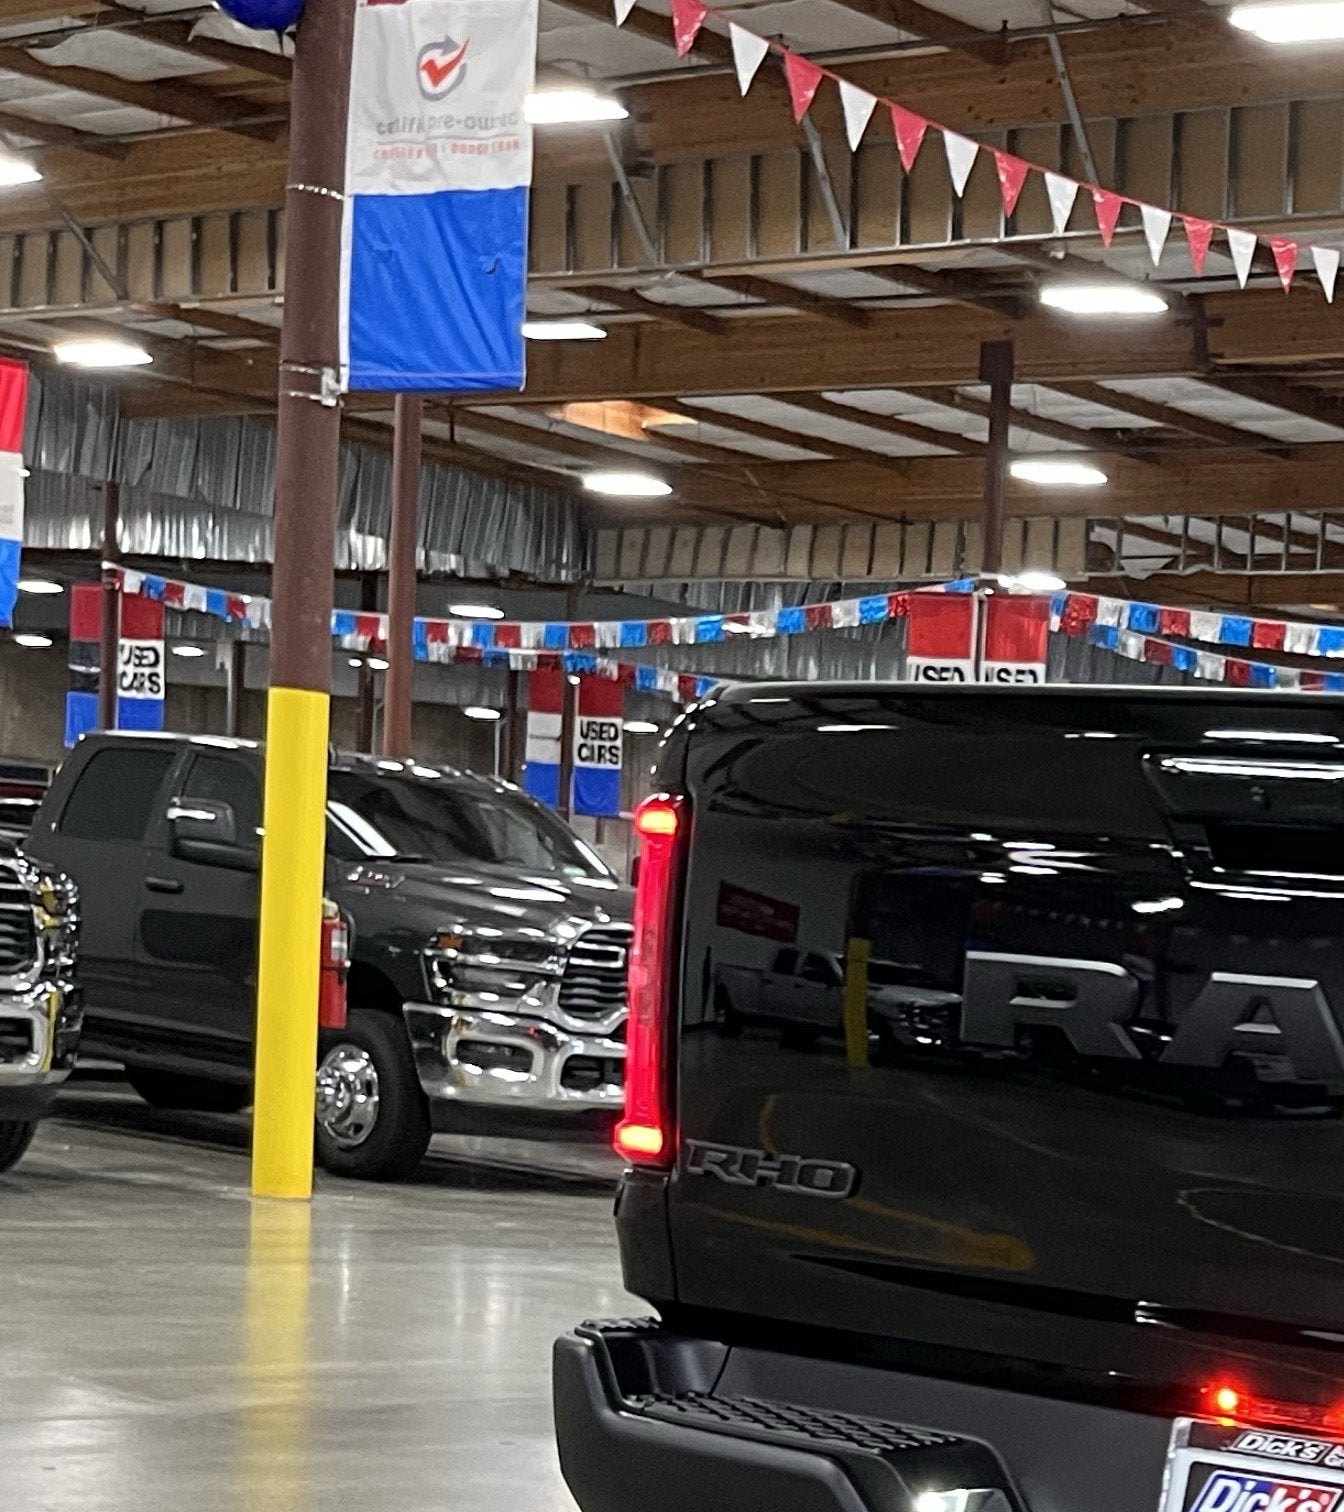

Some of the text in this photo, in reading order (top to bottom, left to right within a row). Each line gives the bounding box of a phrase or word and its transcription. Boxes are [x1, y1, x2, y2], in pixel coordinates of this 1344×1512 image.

[913, 664, 965, 682] SED
[580, 719, 619, 741] USED
[686, 1138, 856, 1199] RHO
